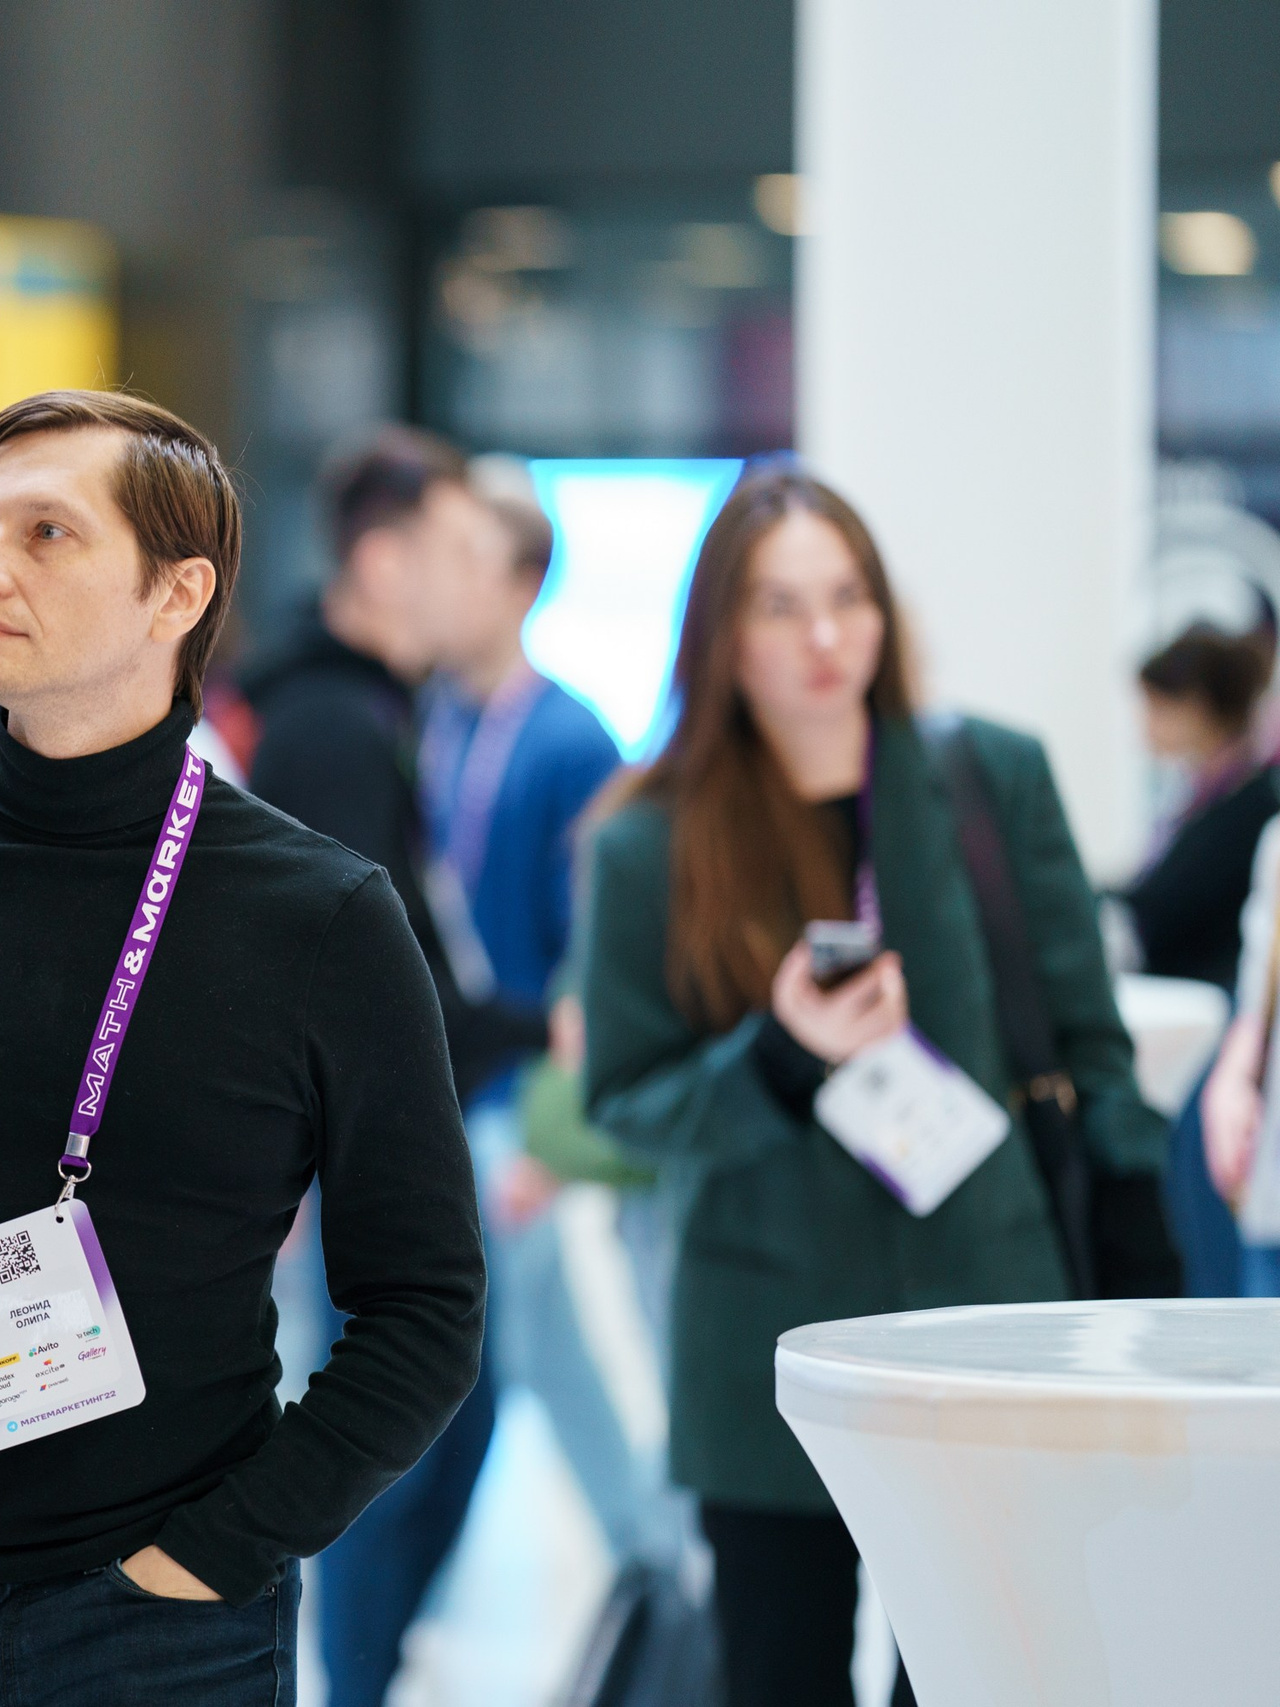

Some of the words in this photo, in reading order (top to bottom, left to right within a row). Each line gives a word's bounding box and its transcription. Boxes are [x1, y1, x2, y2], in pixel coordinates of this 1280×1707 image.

[78, 978, 136, 1117] MATH
[124, 948, 148, 976] &
[10, 1299, 51, 1319] ЛЕОНИД
[15, 1311, 50, 1329] ОЛИПА
[37, 1341, 59, 1354] Avito
[78, 1346, 107, 1362] Gallery
[19, 1389, 117, 1428] МАТЕМАРКЕТИНГ22
